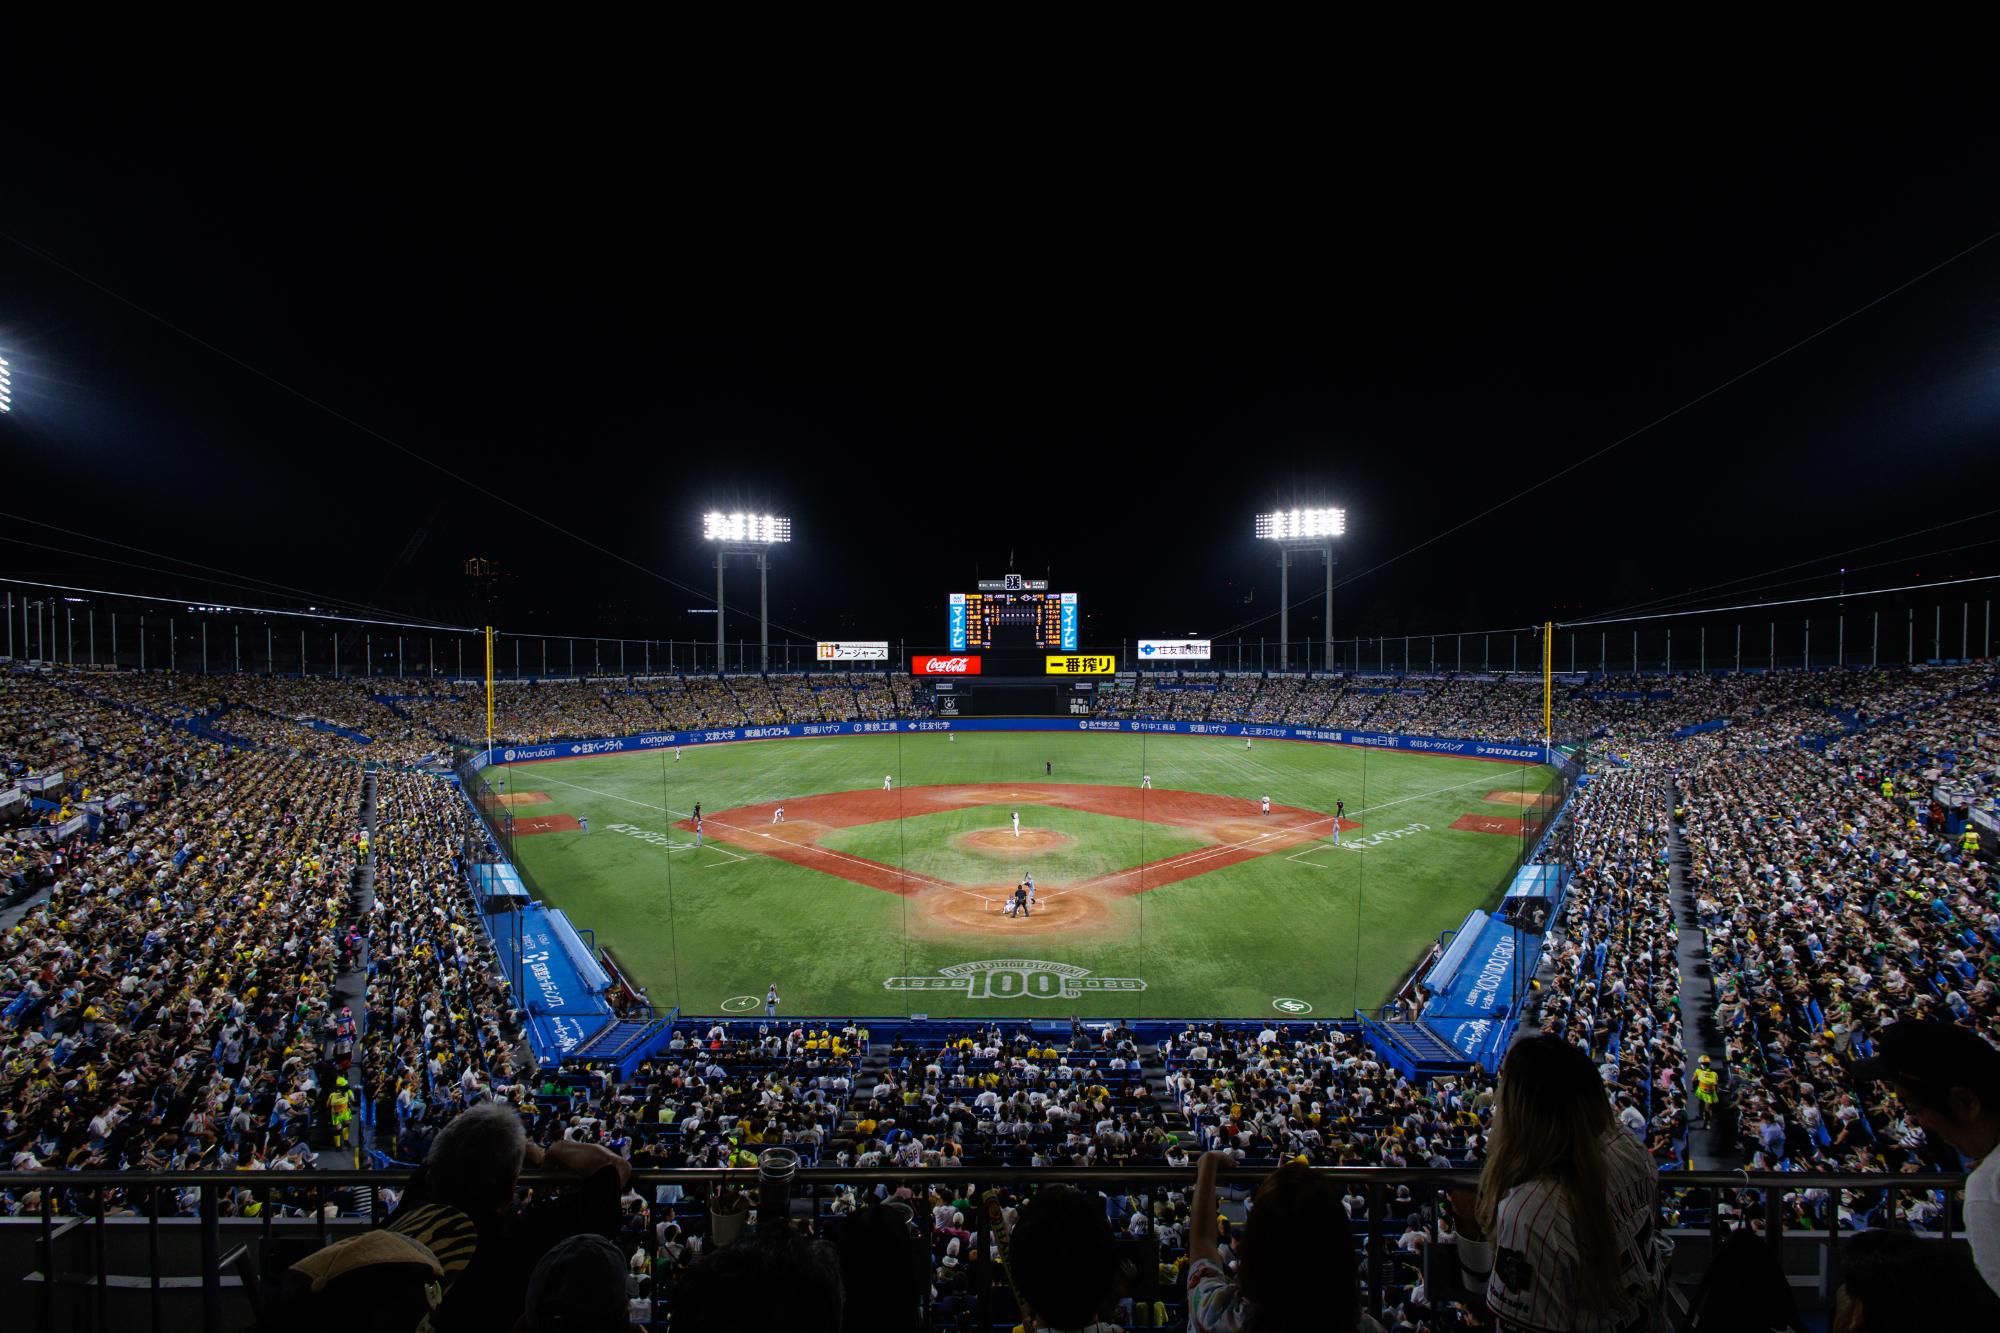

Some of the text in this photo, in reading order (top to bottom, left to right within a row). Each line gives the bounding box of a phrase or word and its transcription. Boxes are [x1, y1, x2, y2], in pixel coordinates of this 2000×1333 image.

[953, 606, 963, 648] マイナビ
[1064, 605, 1074, 647] マイナビ
[837, 649, 886, 658] フージャース
[926, 658, 969, 672] Coca-Cola
[1050, 657, 1111, 672] 一番搾り
[803, 725, 840, 735] 安藤ハザマ
[864, 722, 897, 731] 東鉄工業
[919, 721, 950, 730] 住友化学
[1189, 724, 1227, 734] 安藤ハザマ
[705, 730, 735, 741] 文教大学
[745, 726, 790, 738] 東進ハイスクール
[1249, 727, 1287, 737] 三菱ガス化学
[582, 740, 624, 754] 住友ベークライト
[1486, 747, 1538, 757] DUNLOP
[517, 749, 556, 759] Marubun
[951, 963, 986, 975] MEIJI
[1026, 961, 1080, 975] STADIUM
[967, 970, 1065, 998] 100
